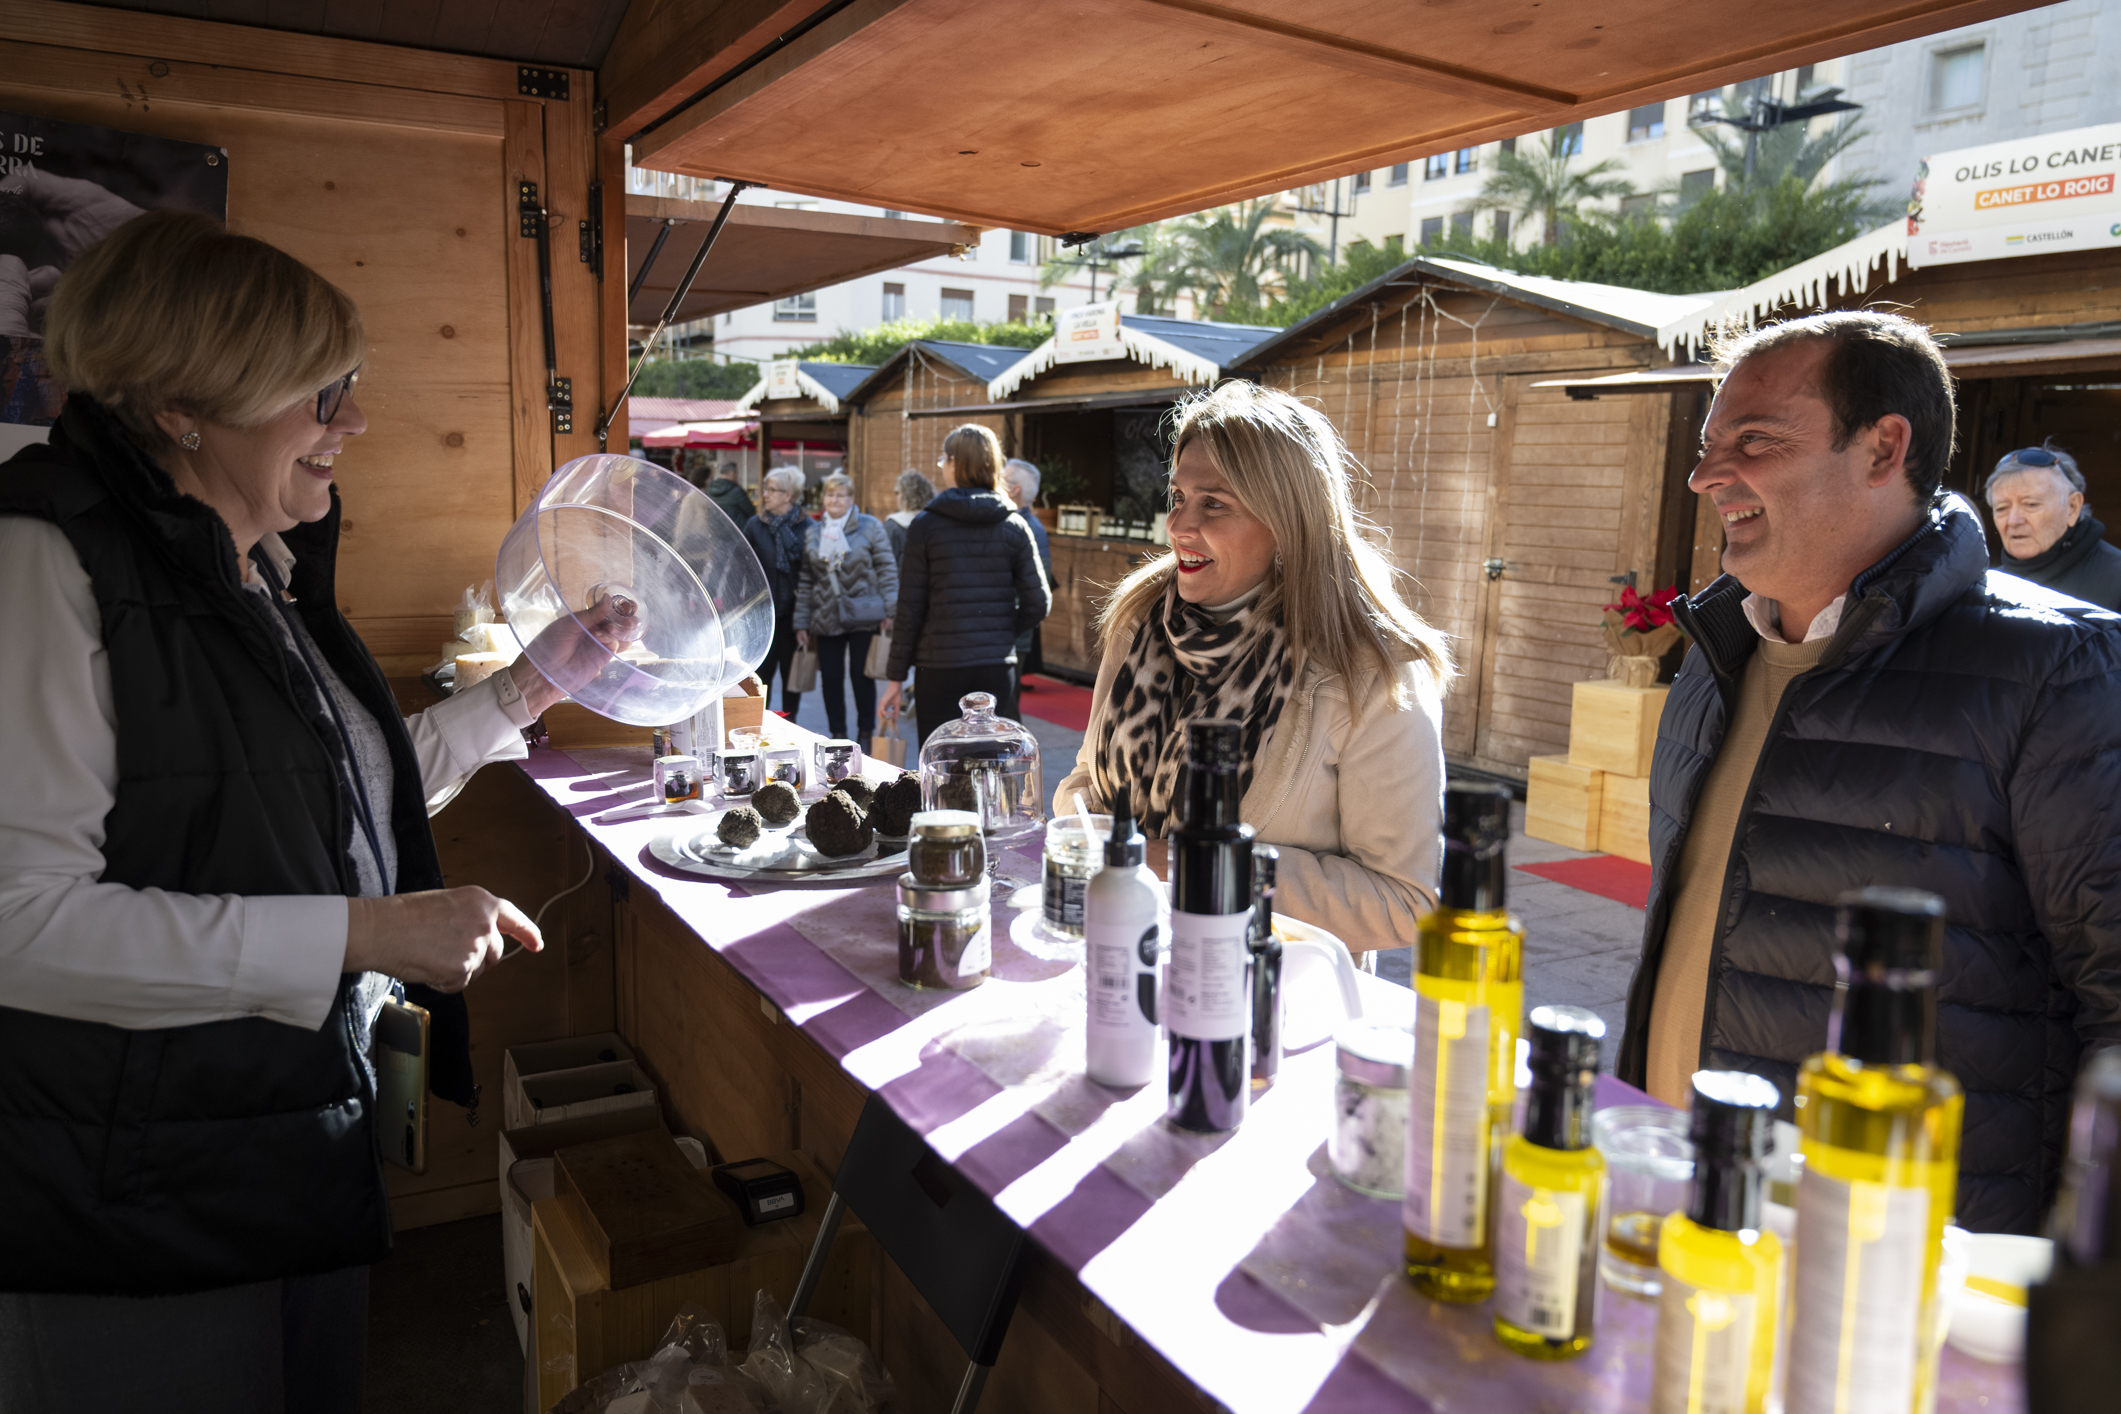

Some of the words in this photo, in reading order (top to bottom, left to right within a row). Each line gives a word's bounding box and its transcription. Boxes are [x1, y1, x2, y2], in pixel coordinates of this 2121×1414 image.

[14, 133, 44, 156] DE
[1955, 161, 2002, 182] OLIS
[2009, 156, 2039, 175] LO
[1978, 186, 2033, 207] CANET
[2037, 183, 2060, 200] LO
[2064, 176, 2109, 196] ROIG
[2026, 229, 2074, 244] CASTELLÓN
[766, 1195, 785, 1206] BBVA
